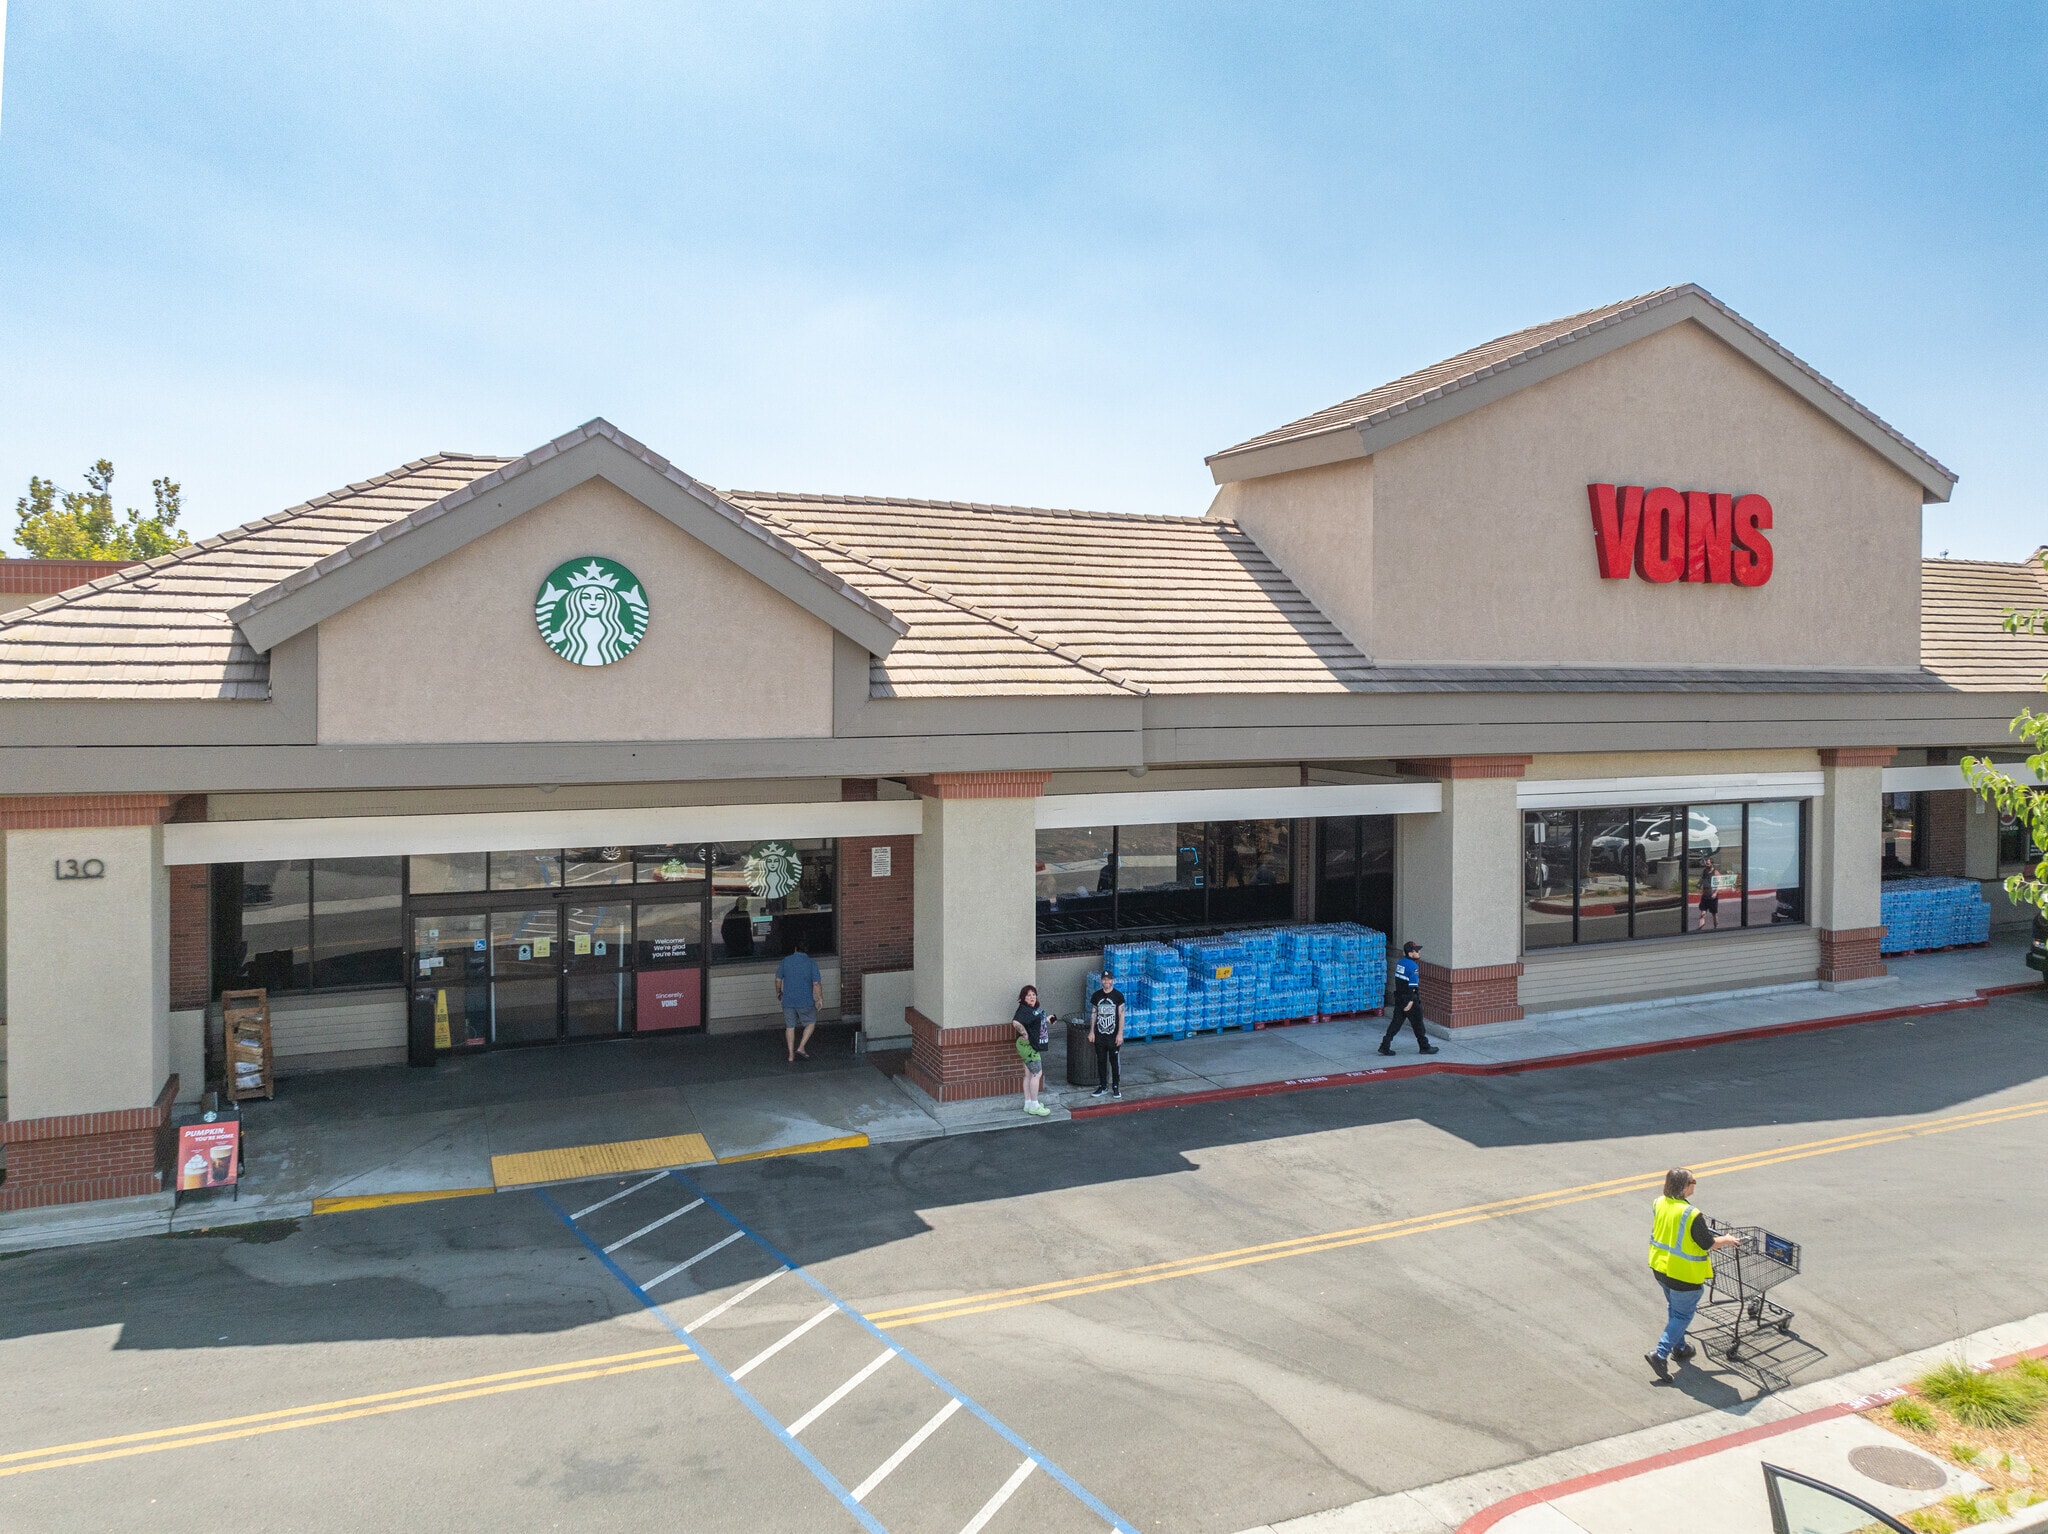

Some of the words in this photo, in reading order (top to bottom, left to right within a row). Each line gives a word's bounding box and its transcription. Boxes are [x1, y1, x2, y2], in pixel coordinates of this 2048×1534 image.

[1587, 483, 1773, 587] VONS
[55, 858, 105, 880] 130
[1844, 1395, 1878, 1408] LANE
[1875, 1386, 1907, 1400] FIRE
